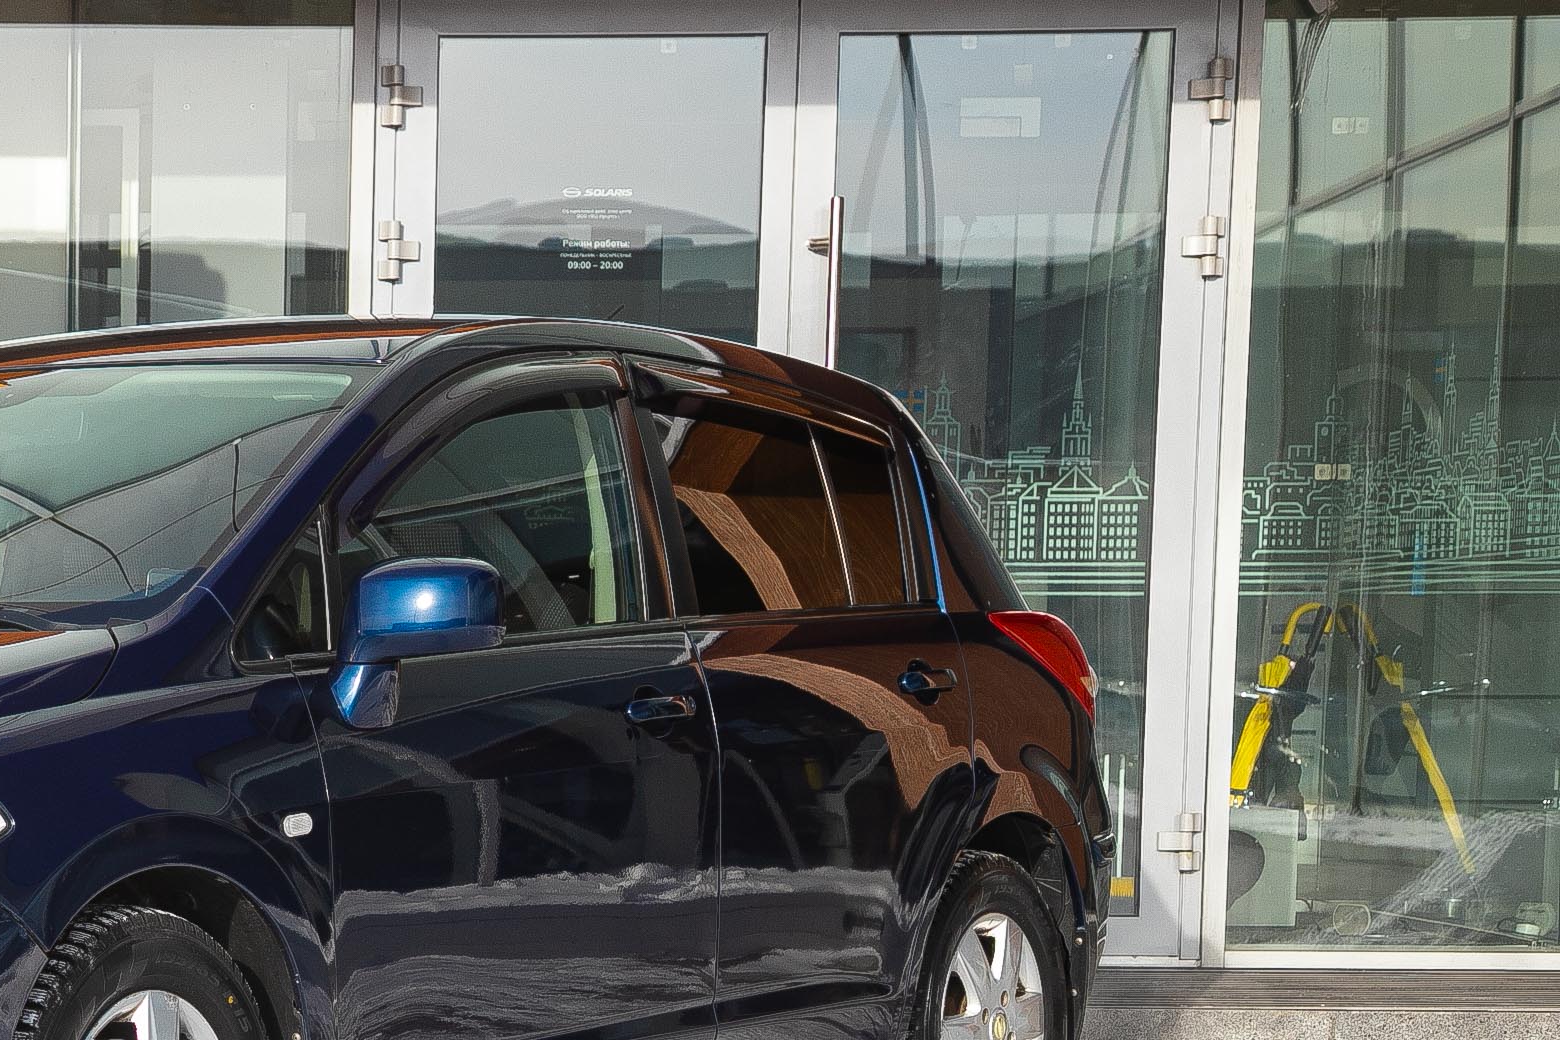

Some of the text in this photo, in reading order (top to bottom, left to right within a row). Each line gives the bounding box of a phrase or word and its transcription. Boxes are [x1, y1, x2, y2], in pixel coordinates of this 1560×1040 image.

[584, 188, 633, 197] SOLARIS
[562, 239, 631, 249] Режим работы:
[567, 261, 591, 269] 09:00
[600, 261, 624, 269] 20:00
